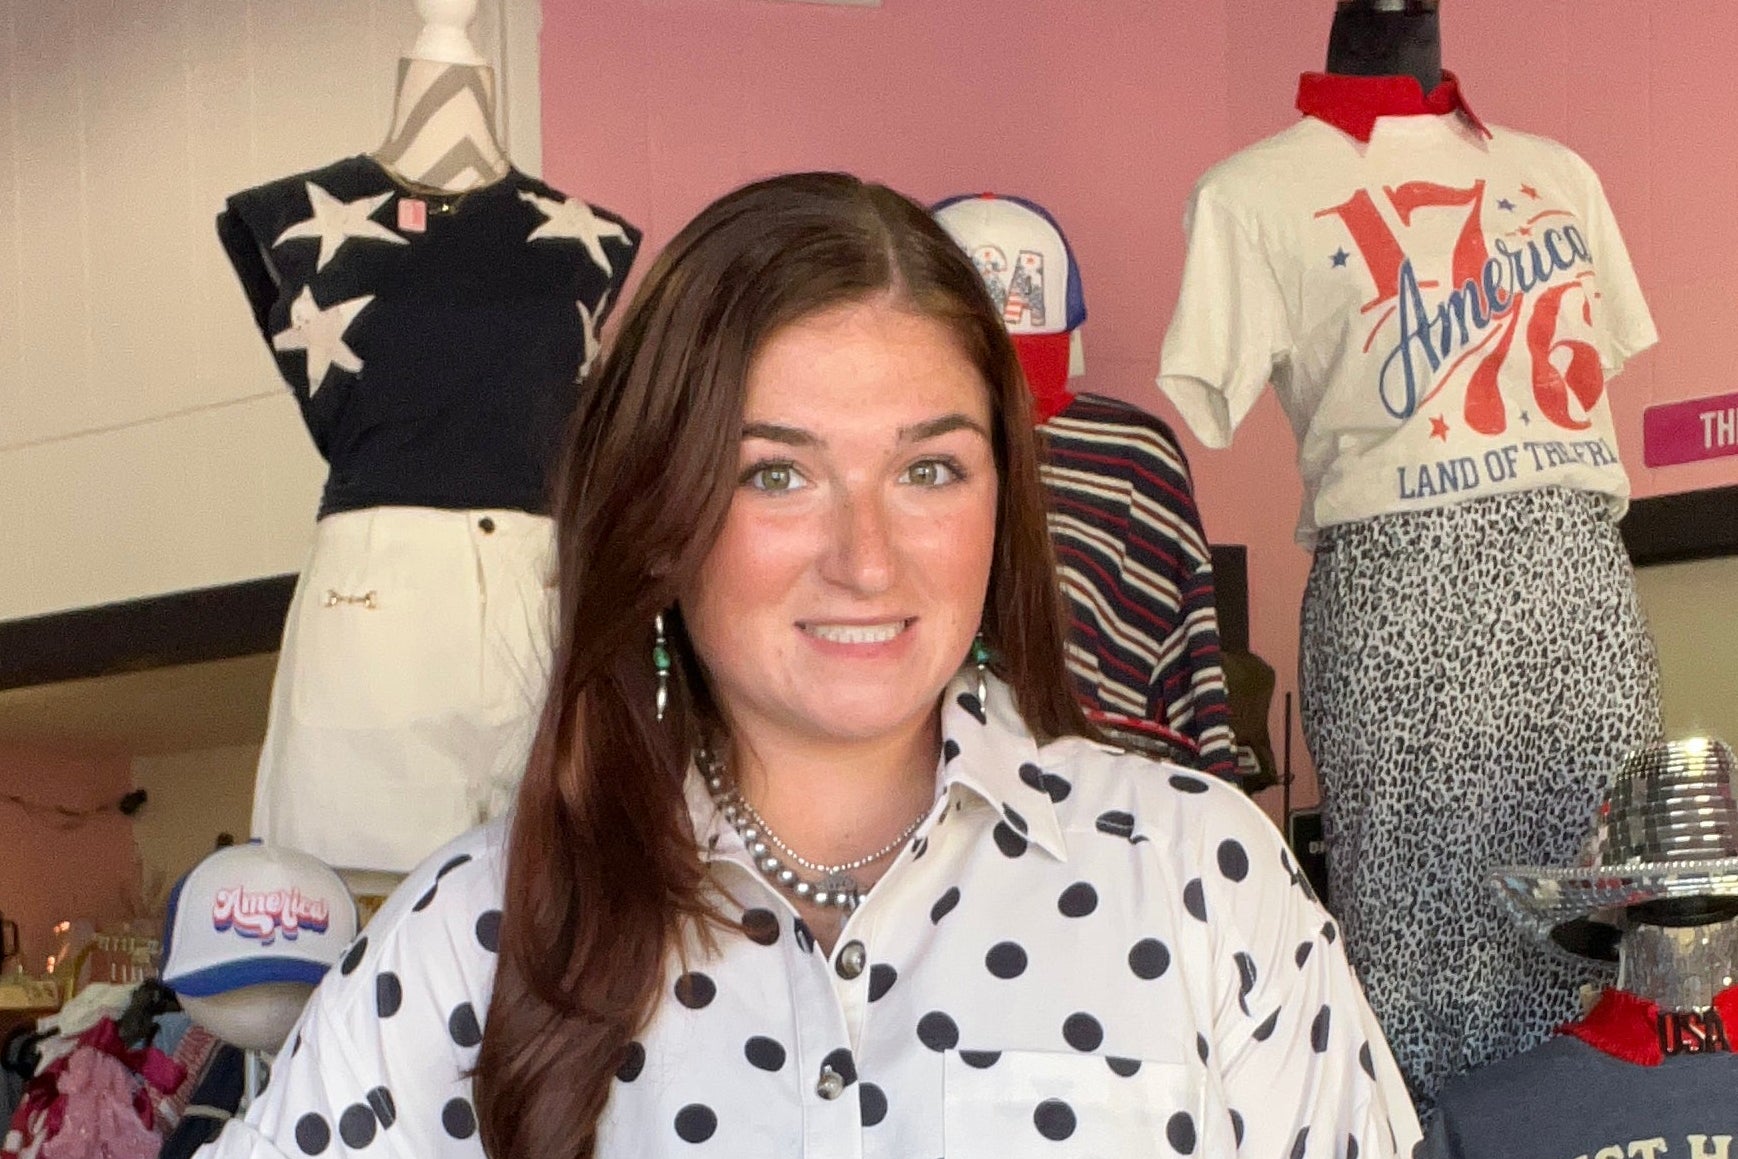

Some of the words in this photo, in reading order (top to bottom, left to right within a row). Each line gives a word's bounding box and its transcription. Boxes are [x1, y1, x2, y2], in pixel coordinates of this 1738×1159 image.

[1379, 225, 1592, 420] America
[1397, 455, 1480, 500] LAND
[1484, 444, 1519, 483] OF
[212, 885, 330, 946] America
[1657, 1006, 1732, 1056] USA
